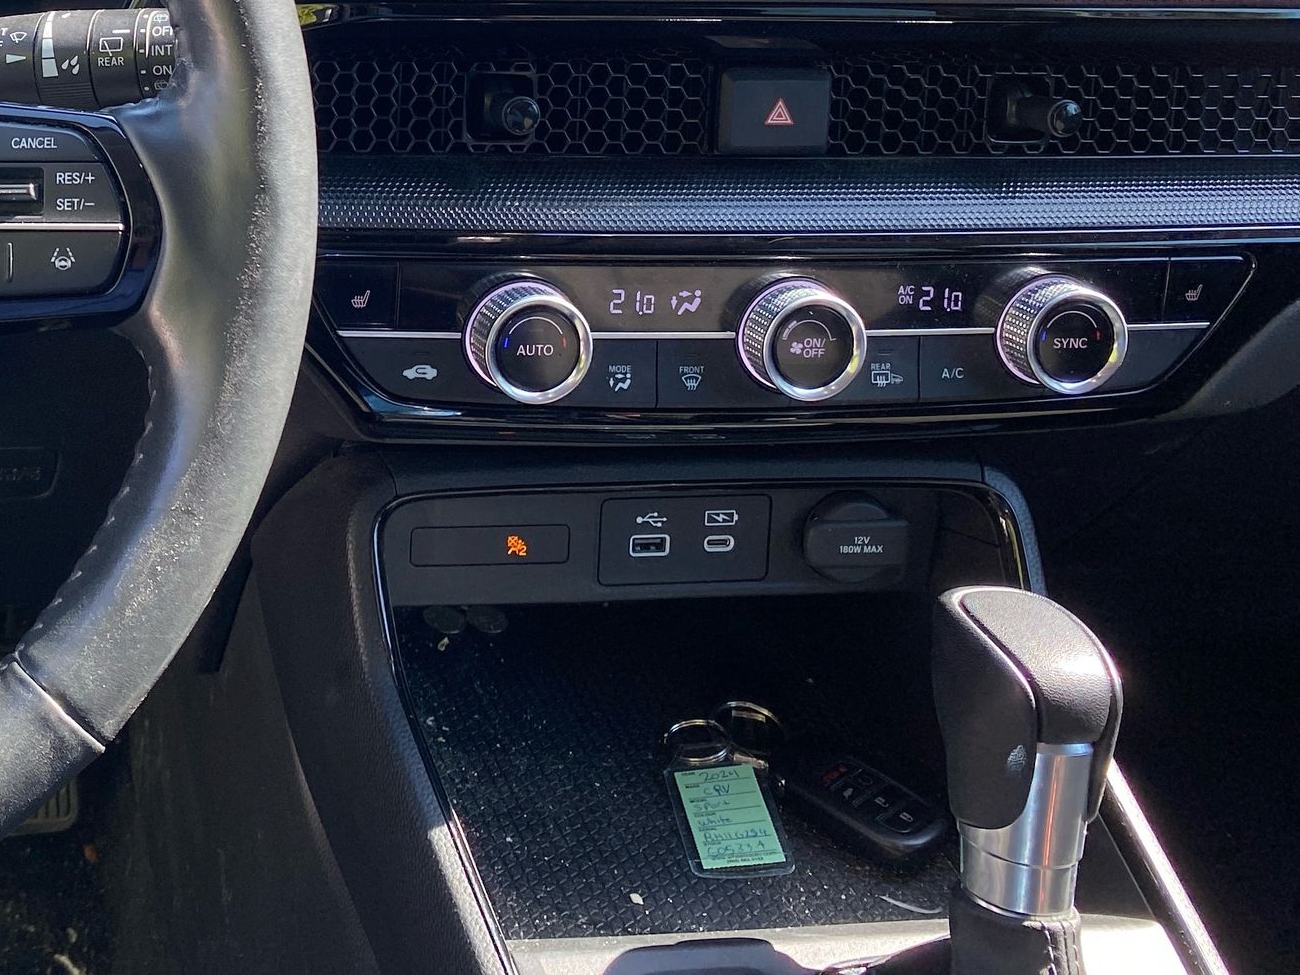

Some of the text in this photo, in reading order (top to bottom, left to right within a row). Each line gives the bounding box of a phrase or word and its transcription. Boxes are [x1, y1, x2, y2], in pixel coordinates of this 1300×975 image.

[151, 44, 173, 56] INT
[98, 57, 124, 67] REAR
[152, 65, 173, 75] ON
[11, 137, 58, 149] CANCEL
[56, 172, 95, 185] RES/+
[898, 285, 915, 295] A/C
[609, 289, 655, 316] 21.0
[898, 295, 913, 305] ON
[918, 286, 963, 313] 21.0
[804, 337, 826, 349] ON/
[1053, 337, 1088, 349] SYNC
[516, 344, 554, 356] AUTO
[803, 348, 825, 359] OFF
[608, 365, 632, 373] MODE
[679, 366, 705, 374] FRONT
[870, 363, 891, 371] REAR
[941, 367, 964, 380] A/C
[853, 536, 870, 545] 12V
[839, 544, 884, 554] 180W MAX
